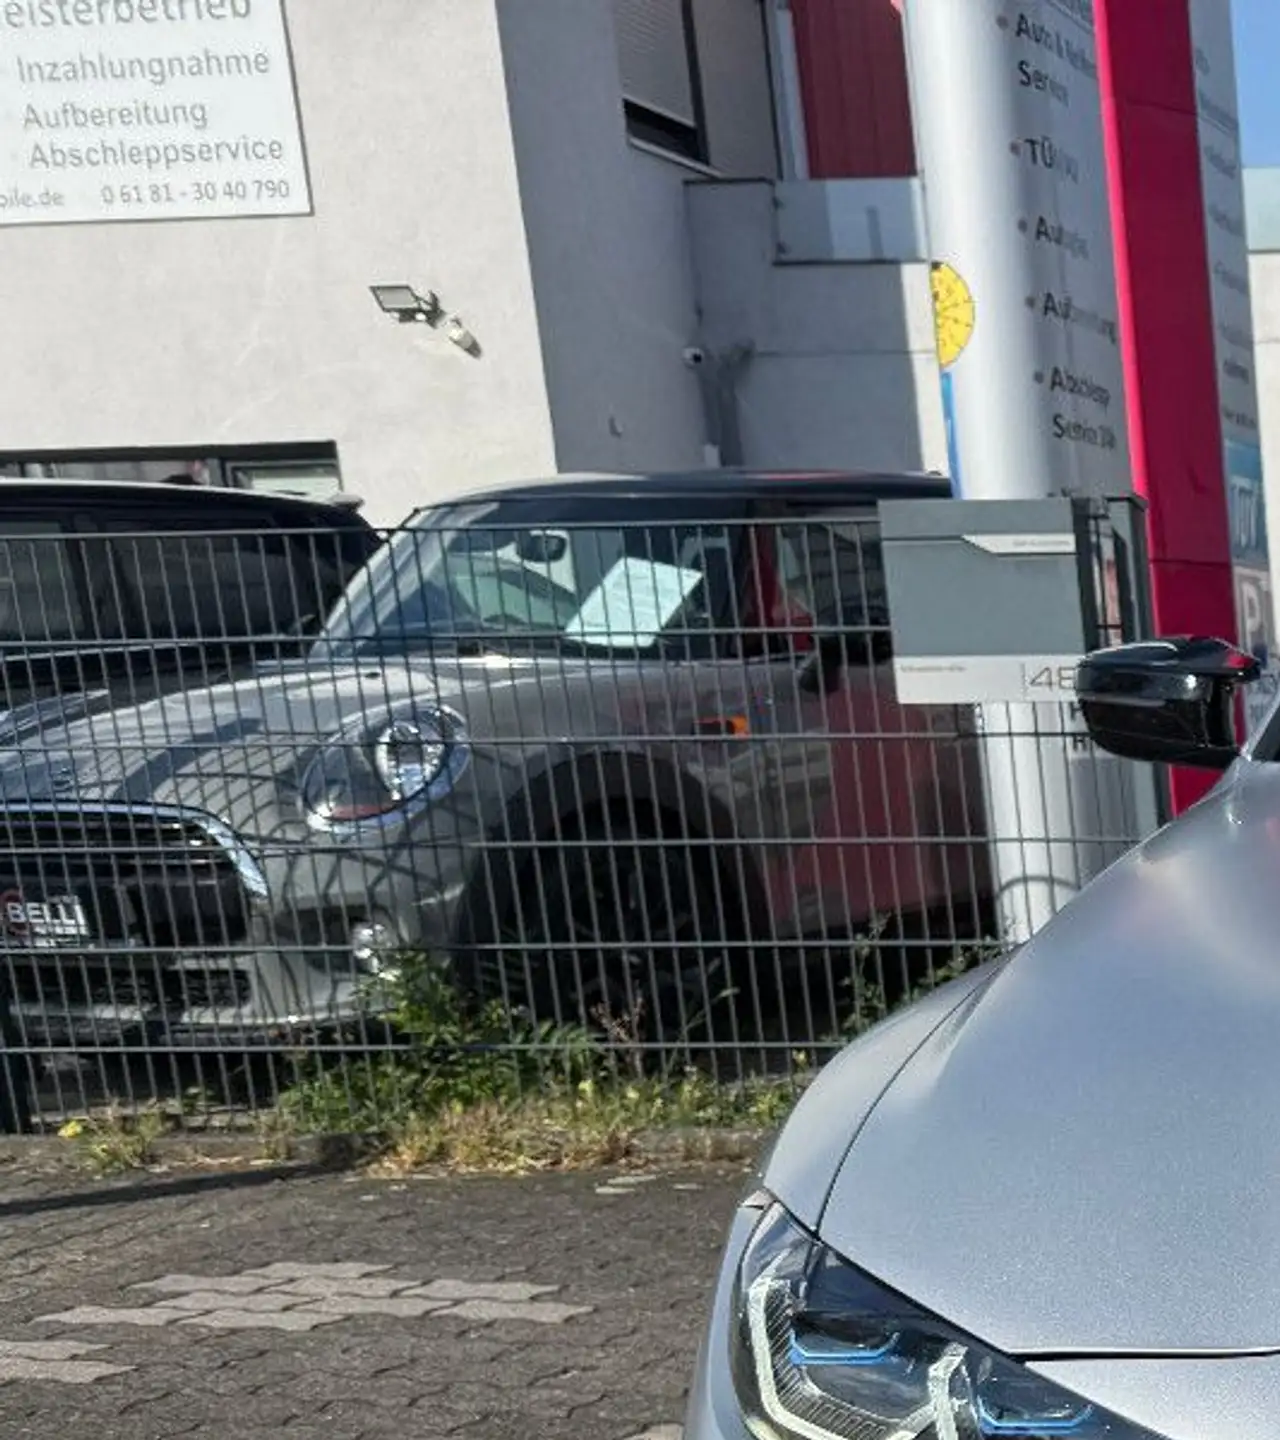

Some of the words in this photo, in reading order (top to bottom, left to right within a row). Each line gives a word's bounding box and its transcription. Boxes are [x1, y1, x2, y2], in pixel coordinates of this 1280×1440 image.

[16, 50, 271, 84] Inzahlungnahme
[24, 101, 207, 129] Aufbereitung
[29, 135, 283, 169] Abschleppservice
[7, 902, 85, 925] BELLI
